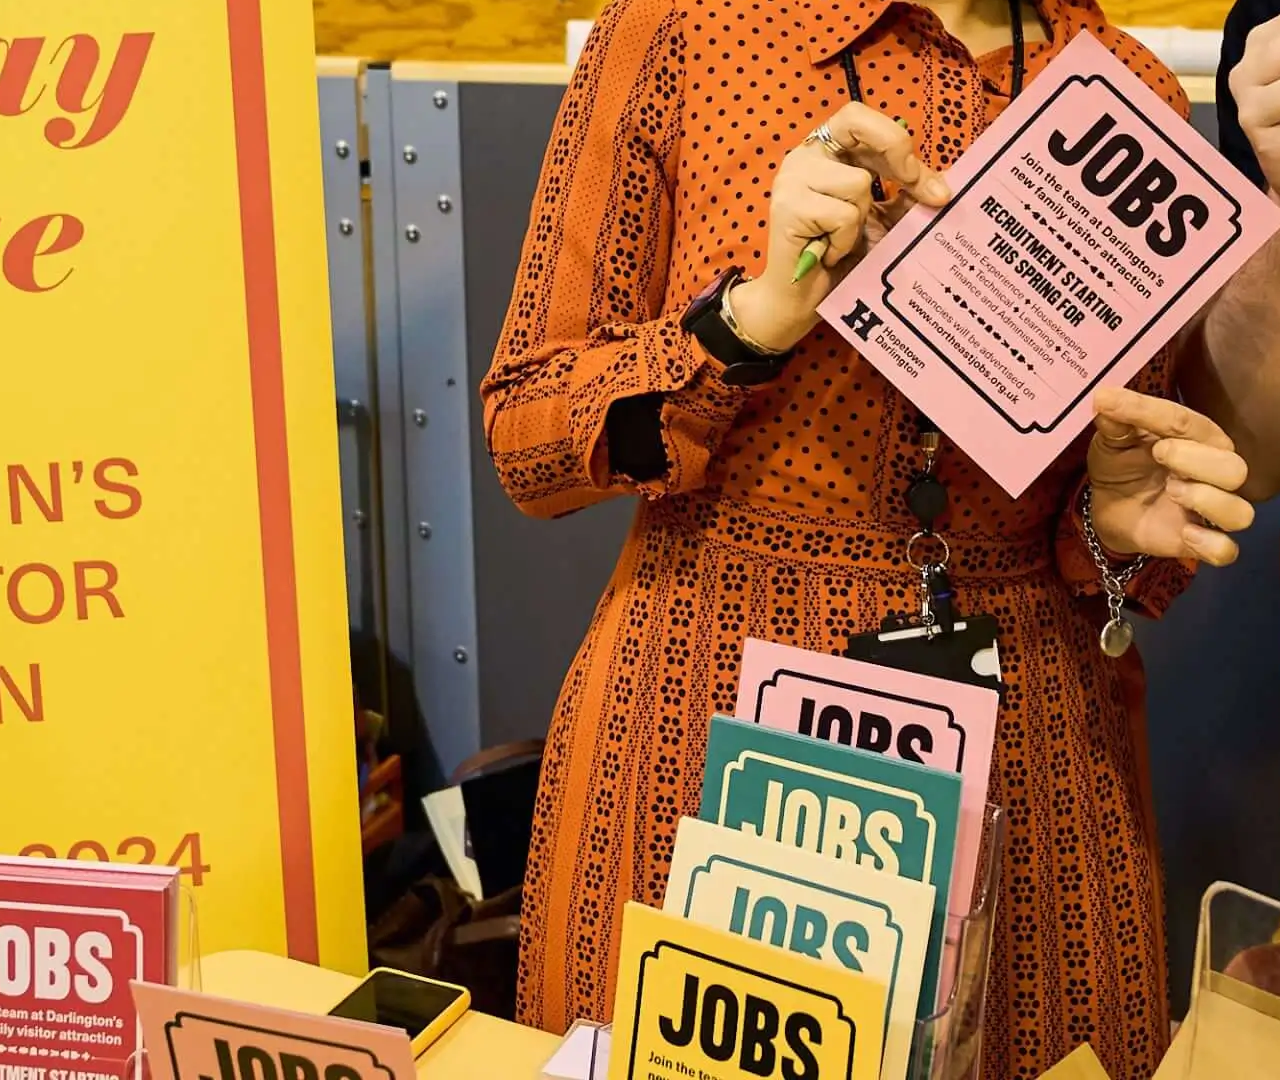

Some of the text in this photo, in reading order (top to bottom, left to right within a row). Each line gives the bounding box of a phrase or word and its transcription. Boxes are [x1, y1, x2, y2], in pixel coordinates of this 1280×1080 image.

[1010, 165, 1152, 300] new family visitor attraction
[1021, 152, 1165, 288] Join the team at Darlington's
[1048, 112, 1209, 257] JOBS
[934, 232, 1088, 379] Catering Technical Learning Events
[949, 264, 1055, 366] Finance and Administration
[955, 231, 1088, 360] Visitor Experience Housekeeping
[980, 195, 1123, 332] RECRUITMENT STARTING
[987, 232, 1085, 328] THIS SPRING FOR
[874, 335, 919, 379] Darlington
[882, 326, 926, 369] Hopetown
[908, 298, 1020, 405] www.northeastjobs.org.uk
[912, 280, 1036, 401] Vacancies will be advertised on
[741, 781, 904, 876] JOBS
[728, 886, 869, 972] JOBS
[17, 1026, 56, 1040] visitor
[59, 1030, 122, 1046] attraction
[31, 1010, 44, 1021] at
[46, 1009, 123, 1028] Darlington's
[648, 1050, 672, 1069] Join
[676, 1061, 695, 1077] the
[659, 972, 823, 1080] JOBS
